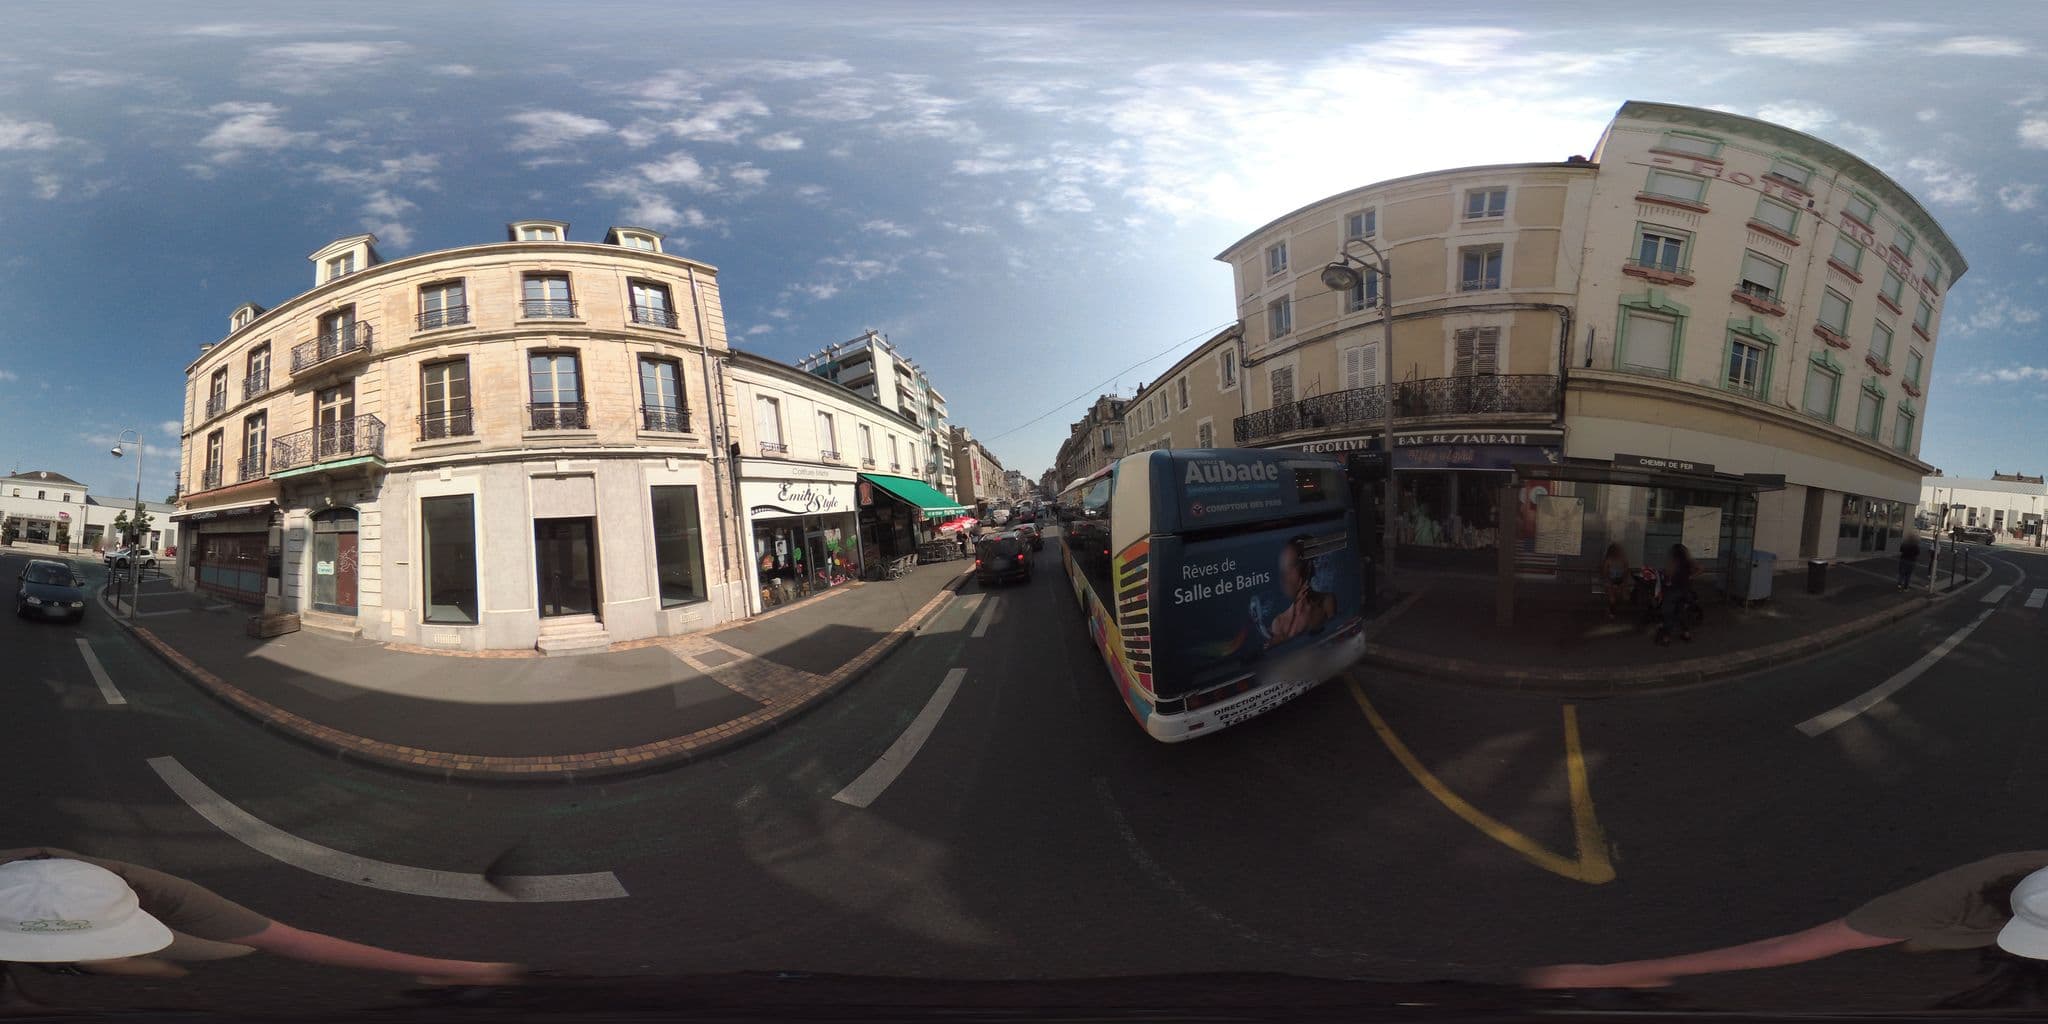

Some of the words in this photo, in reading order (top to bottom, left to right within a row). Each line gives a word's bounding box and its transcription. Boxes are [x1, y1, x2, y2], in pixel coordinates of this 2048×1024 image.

[1840, 218, 1931, 298] MODERNE
[1302, 440, 1368, 453] BROOKLYN
[1184, 460, 1279, 484] Aubade
[1639, 458, 1666, 468] CHEMIN
[1668, 461, 1679, 469] DE
[1681, 462, 1694, 471] FER
[1182, 563, 1219, 580] Rêves
[1221, 557, 1236, 572] de
[1174, 583, 1212, 604] Salle
[1215, 579, 1233, 595] de
[1236, 571, 1270, 590] Bains
[1214, 692, 1262, 716] DIRECTION
